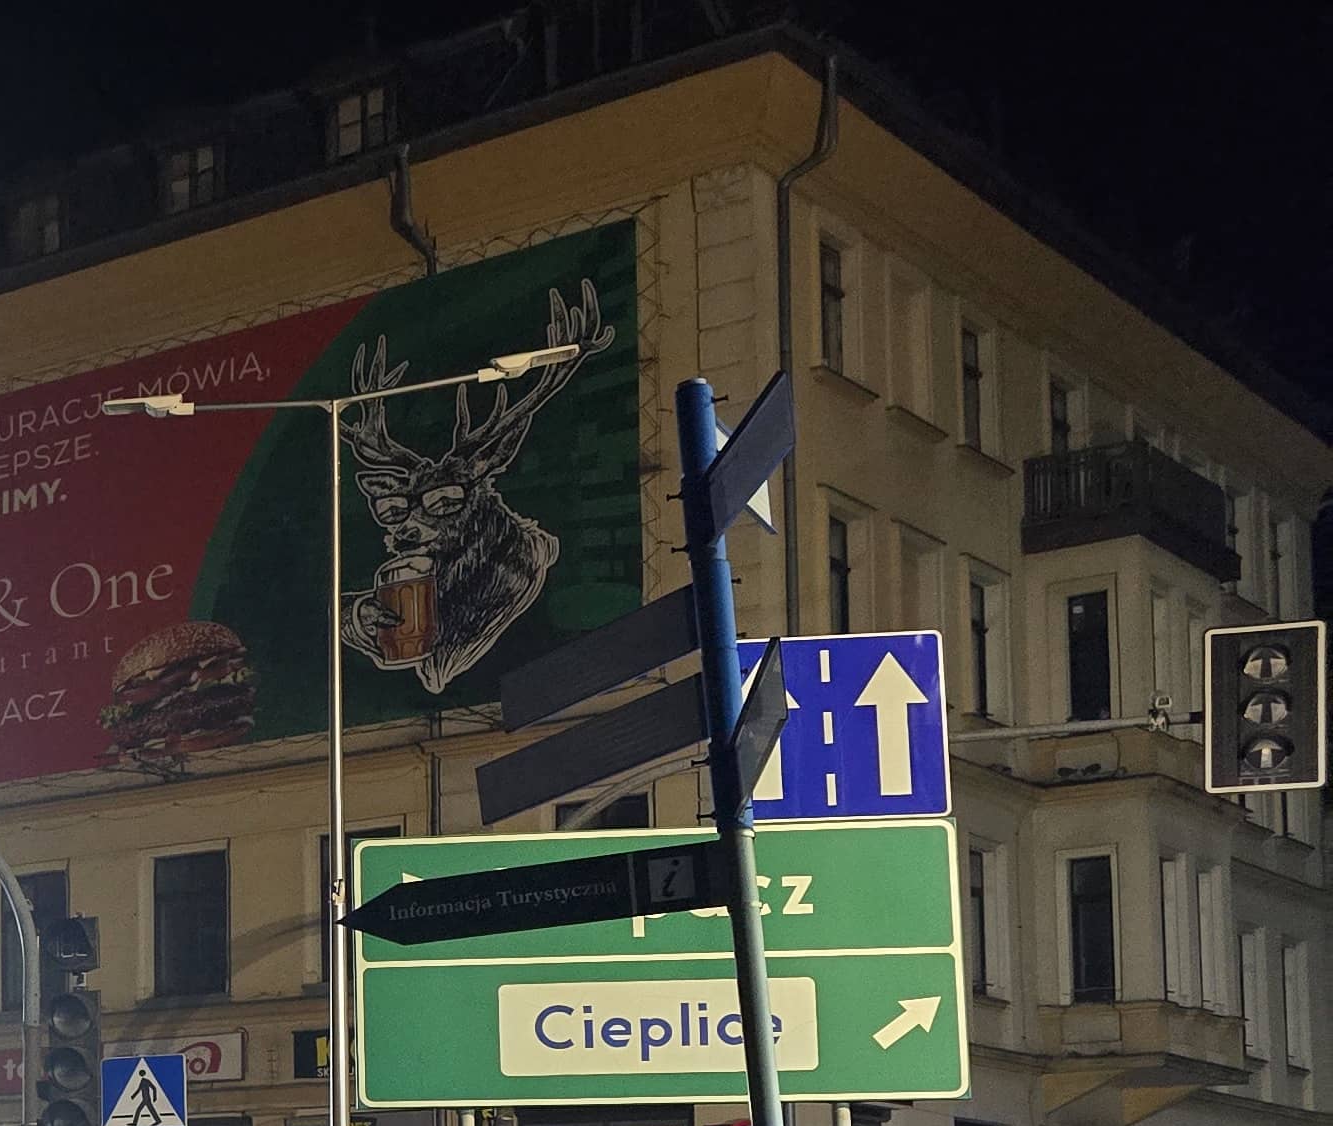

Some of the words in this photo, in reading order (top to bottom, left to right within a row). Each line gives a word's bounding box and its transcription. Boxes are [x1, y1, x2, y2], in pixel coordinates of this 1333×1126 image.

[50, 562, 174, 618] One
[388, 895, 493, 921] Informacja
[495, 880, 617, 907] Turystyczna
